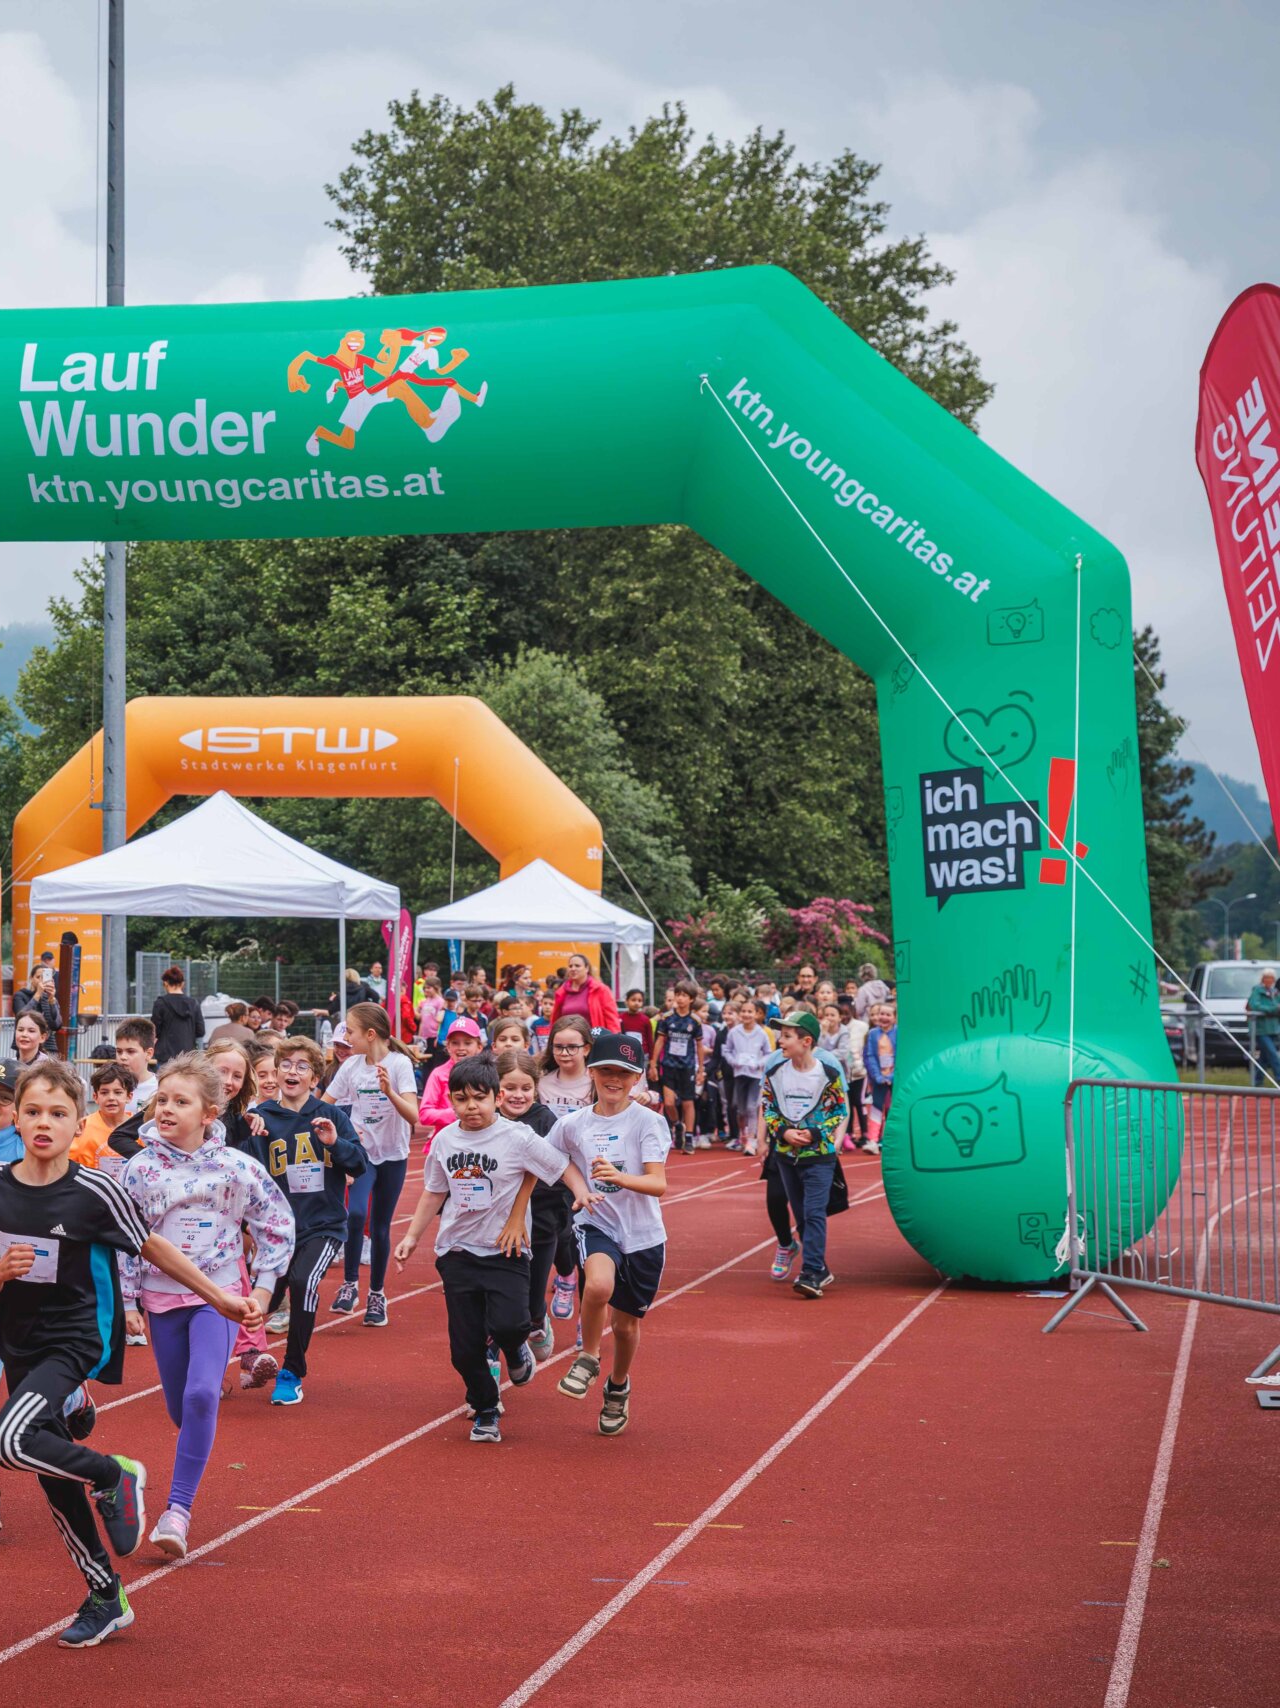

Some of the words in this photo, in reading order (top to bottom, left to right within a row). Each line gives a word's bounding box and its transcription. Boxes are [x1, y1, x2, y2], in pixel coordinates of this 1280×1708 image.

[19, 340, 169, 392] Lauf
[18, 398, 277, 457] Wunder
[27, 466, 445, 511] ktn.youngcaritas.at
[725, 377, 992, 604] ktn.youngcaritas.at
[207, 727, 369, 754] STW
[180, 758, 286, 771] Stadtwerke
[296, 759, 399, 774] Klagenfurt
[923, 776, 978, 817] ich
[926, 811, 1034, 852] mach
[929, 846, 1018, 889] was!
